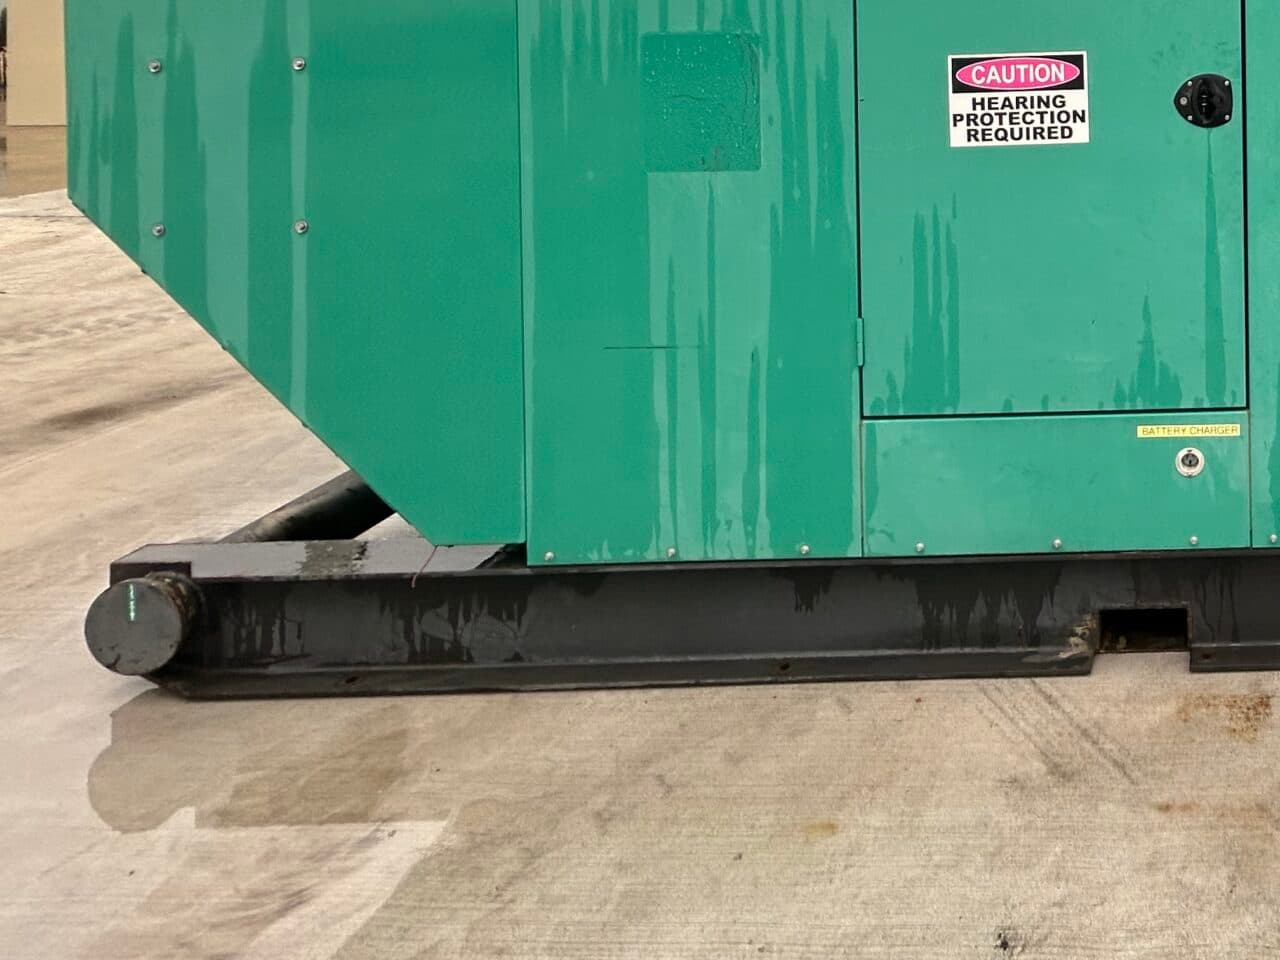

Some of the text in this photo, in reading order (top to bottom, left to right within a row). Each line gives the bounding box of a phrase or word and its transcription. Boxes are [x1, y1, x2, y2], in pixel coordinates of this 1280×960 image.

[971, 63, 1066, 85] CAUTION
[971, 94, 1067, 111] HEARING
[952, 109, 1087, 128] PROTECTION
[966, 125, 1074, 143] REQUIRED
[1142, 426, 1238, 436] BATTERY CHARGER
